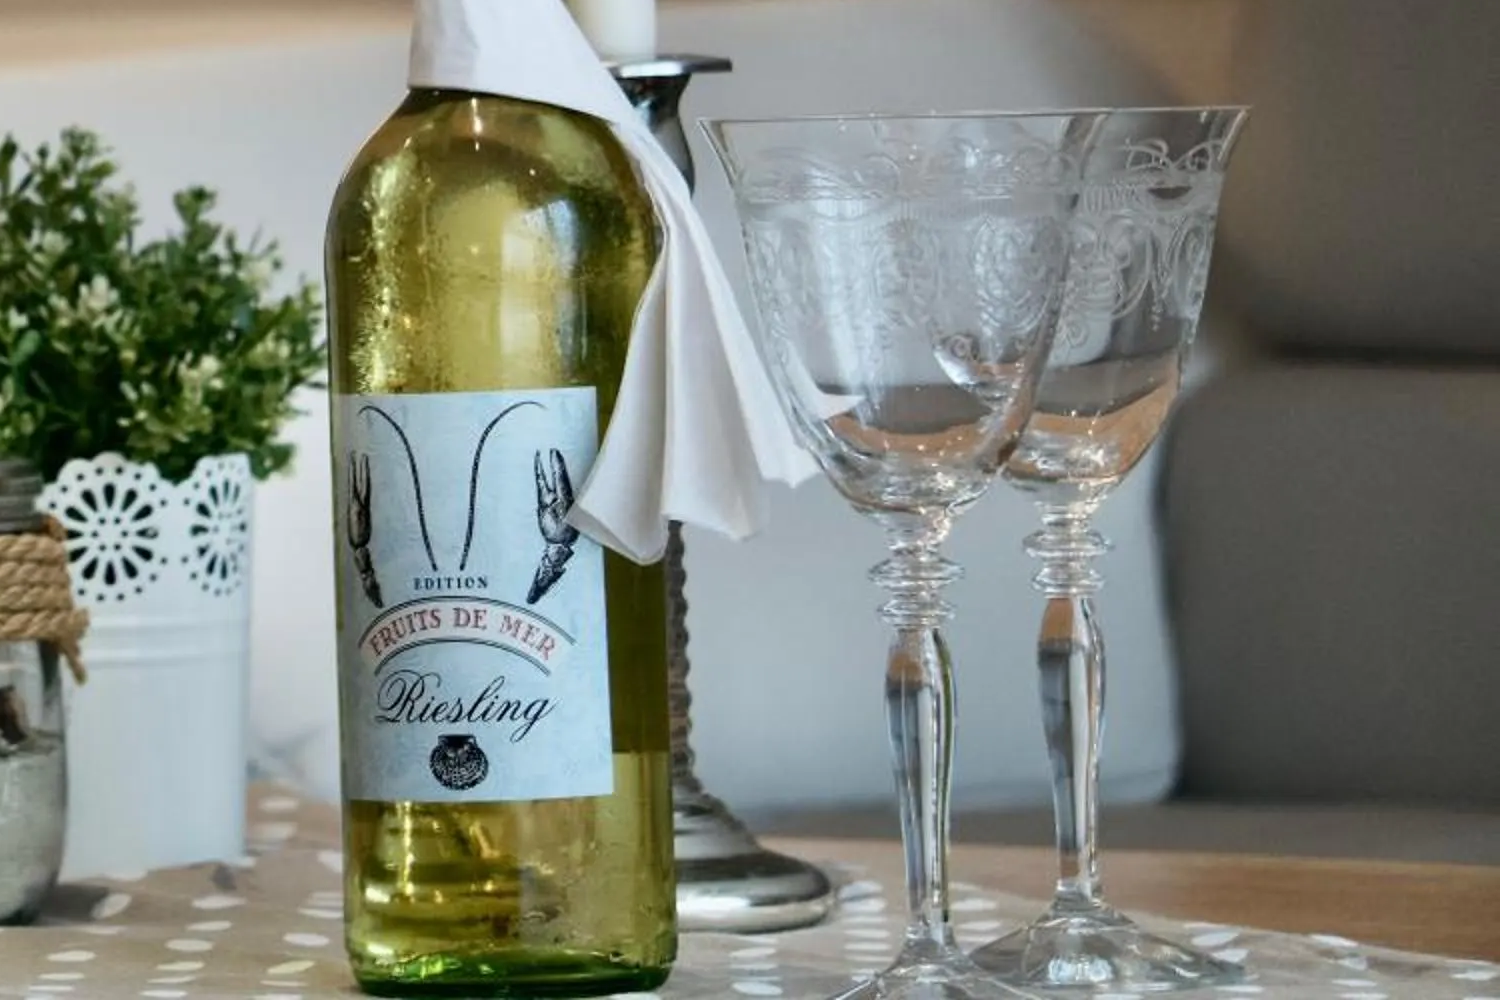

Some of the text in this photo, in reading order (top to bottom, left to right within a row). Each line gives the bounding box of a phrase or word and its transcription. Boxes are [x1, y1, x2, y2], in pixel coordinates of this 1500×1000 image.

[413, 576, 489, 590] EDITION
[369, 607, 556, 661] FRUITS DE MER
[374, 669, 558, 743] Riesling
